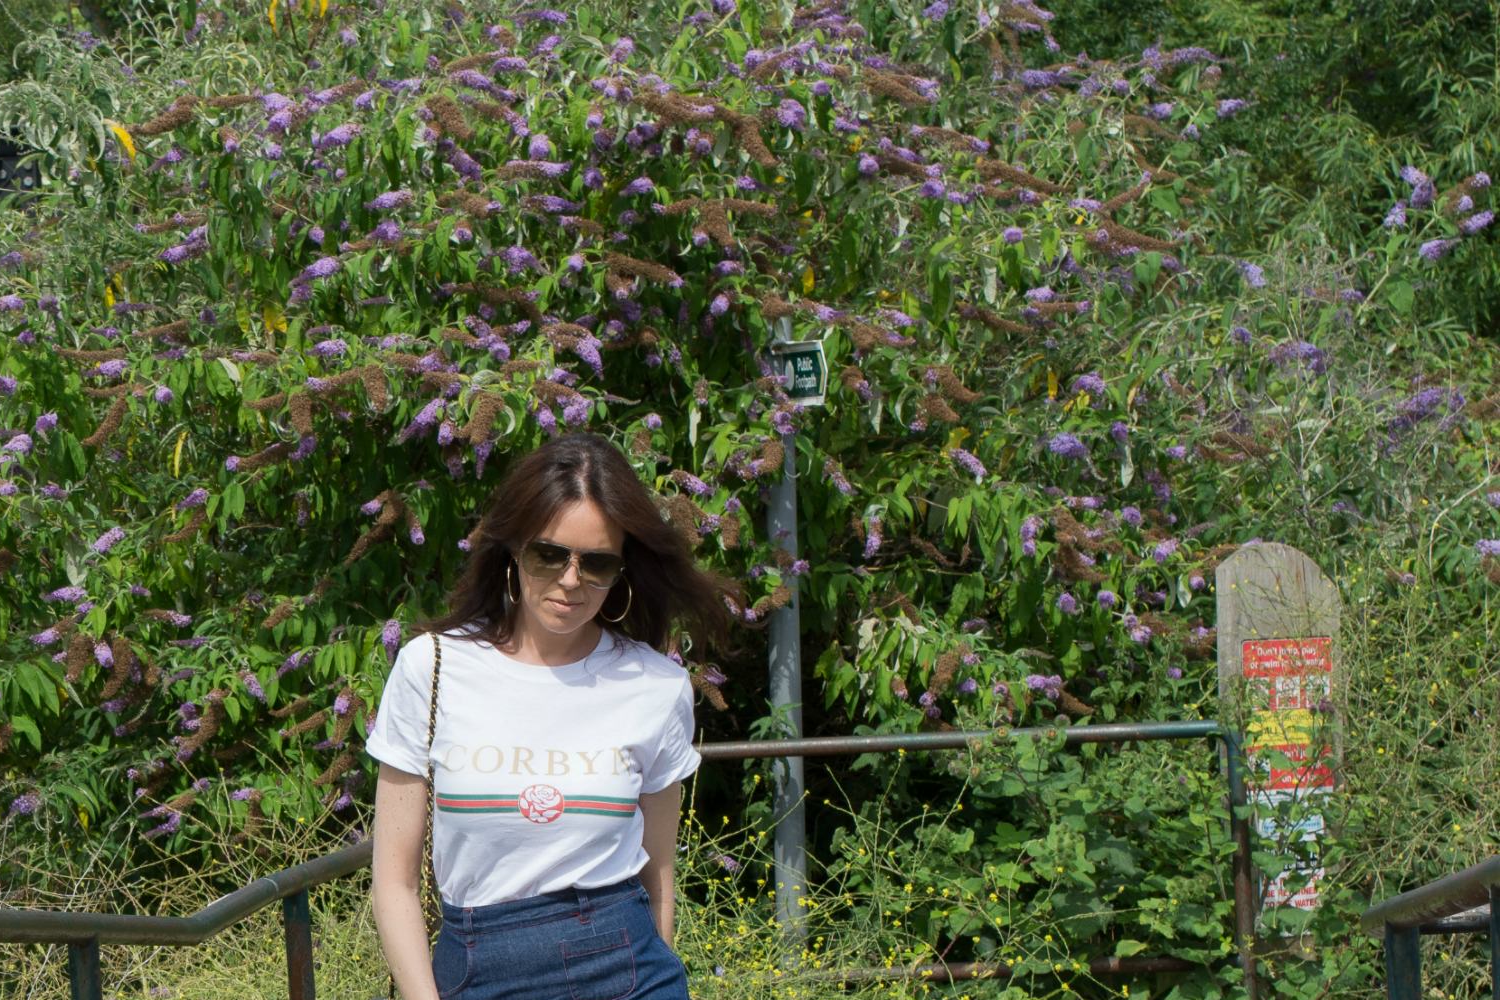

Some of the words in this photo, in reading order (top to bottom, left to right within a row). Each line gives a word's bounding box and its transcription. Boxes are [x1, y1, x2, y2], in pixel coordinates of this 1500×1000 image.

[797, 357, 813, 371] Public
[795, 374, 817, 390] Footpath
[1257, 647, 1277, 656] Don't
